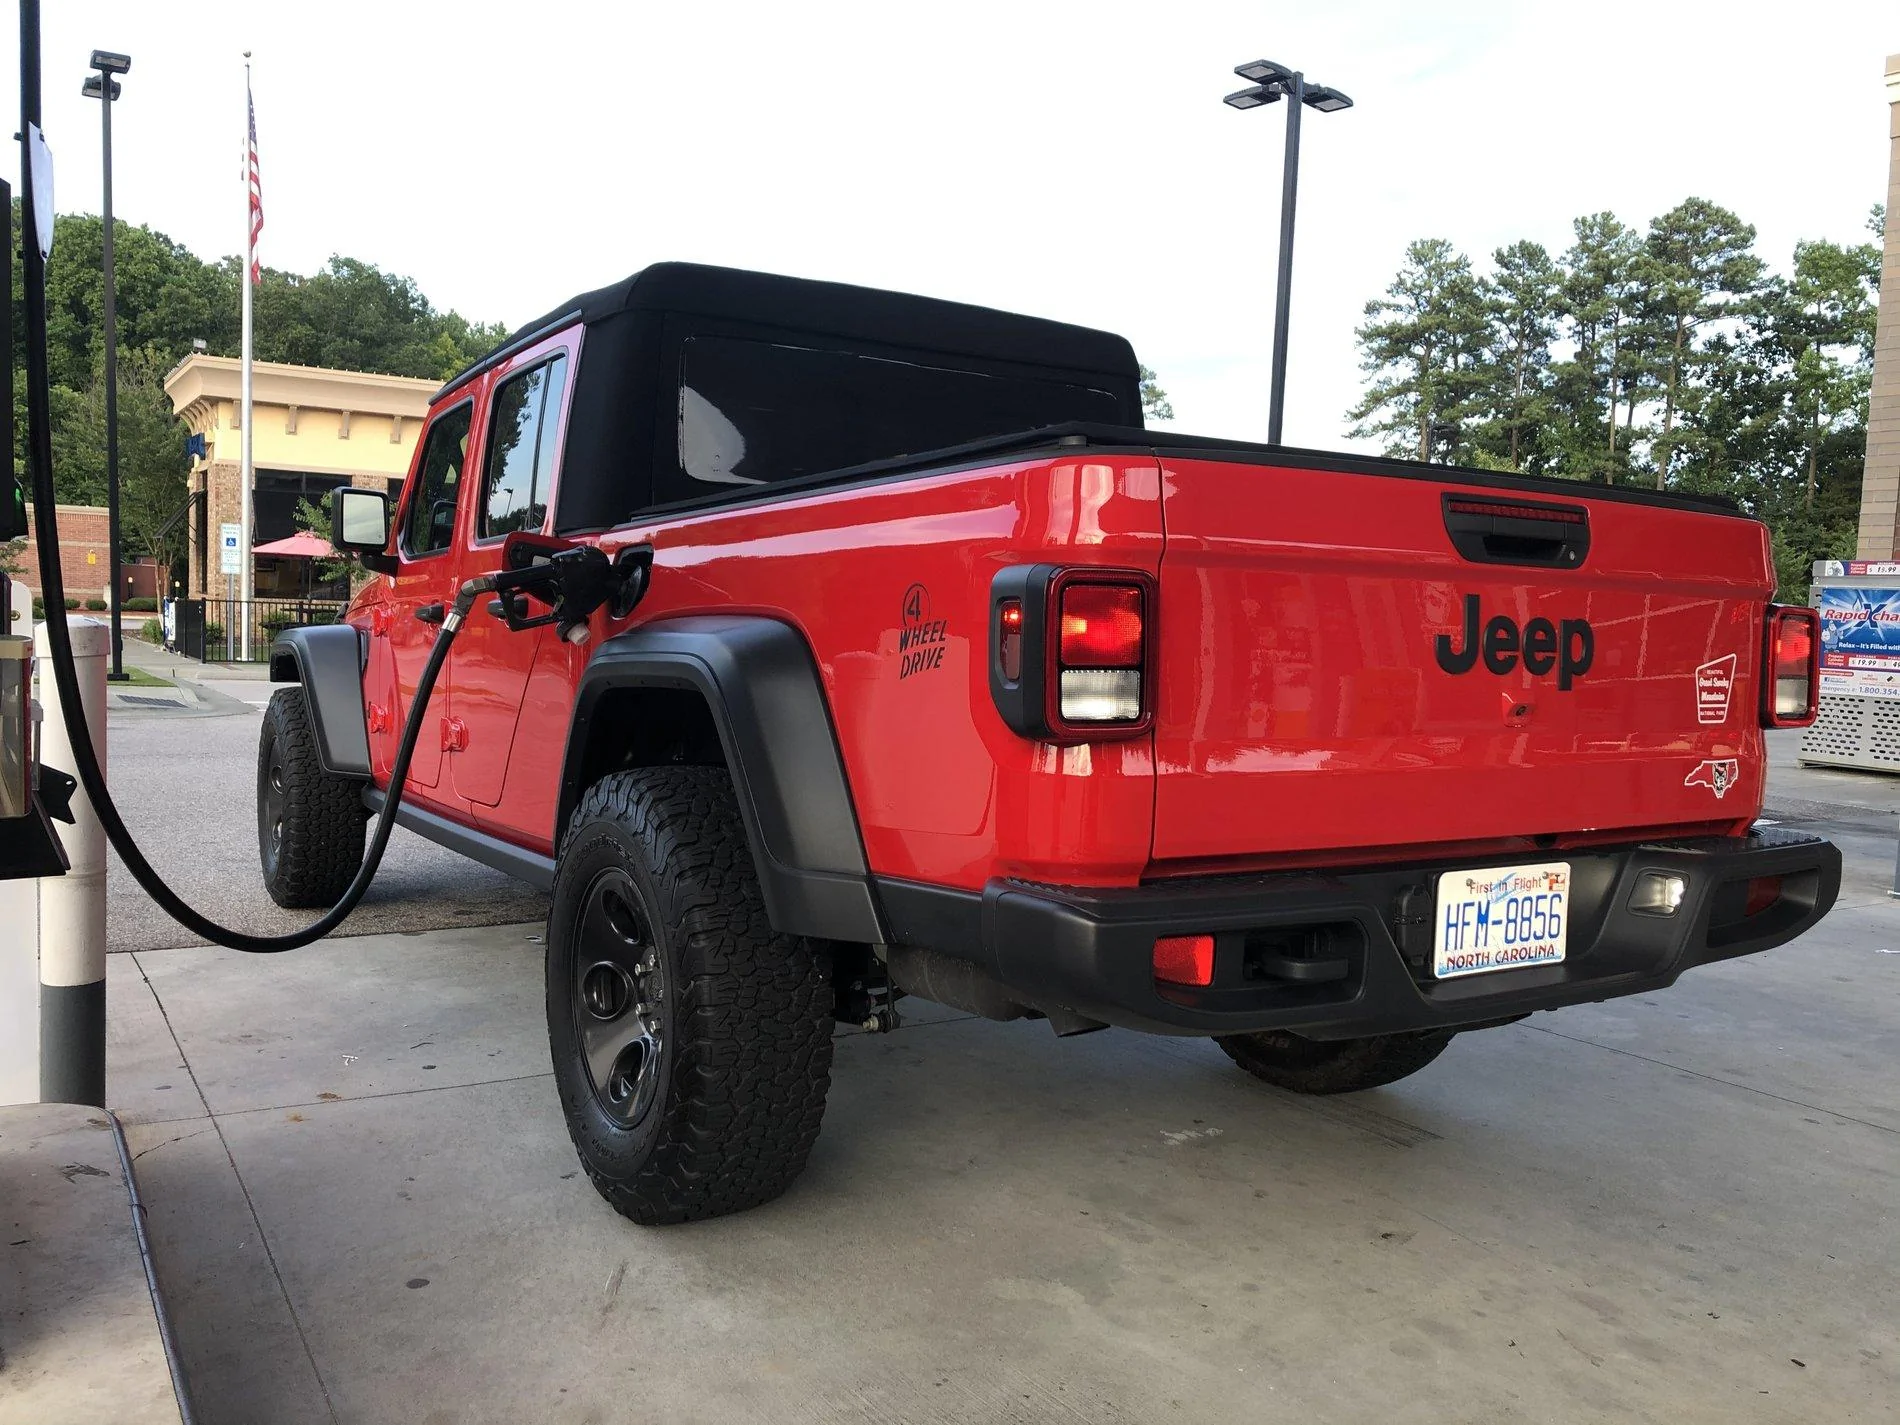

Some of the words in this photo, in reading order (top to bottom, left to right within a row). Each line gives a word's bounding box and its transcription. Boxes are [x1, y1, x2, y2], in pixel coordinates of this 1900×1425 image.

[907, 590, 921, 622] 4
[899, 619, 947, 653] WHEEL
[1436, 593, 1594, 691] Jeep
[900, 647, 945, 680] DRIVE
[1820, 685, 1850, 693] mergency
[1468, 881, 1493, 894] First
[1514, 876, 1542, 893] Flight
[1445, 893, 1562, 951] HFM-8856
[1447, 951, 1490, 970] NORTH
[1495, 944, 1555, 964] CAROLINA
